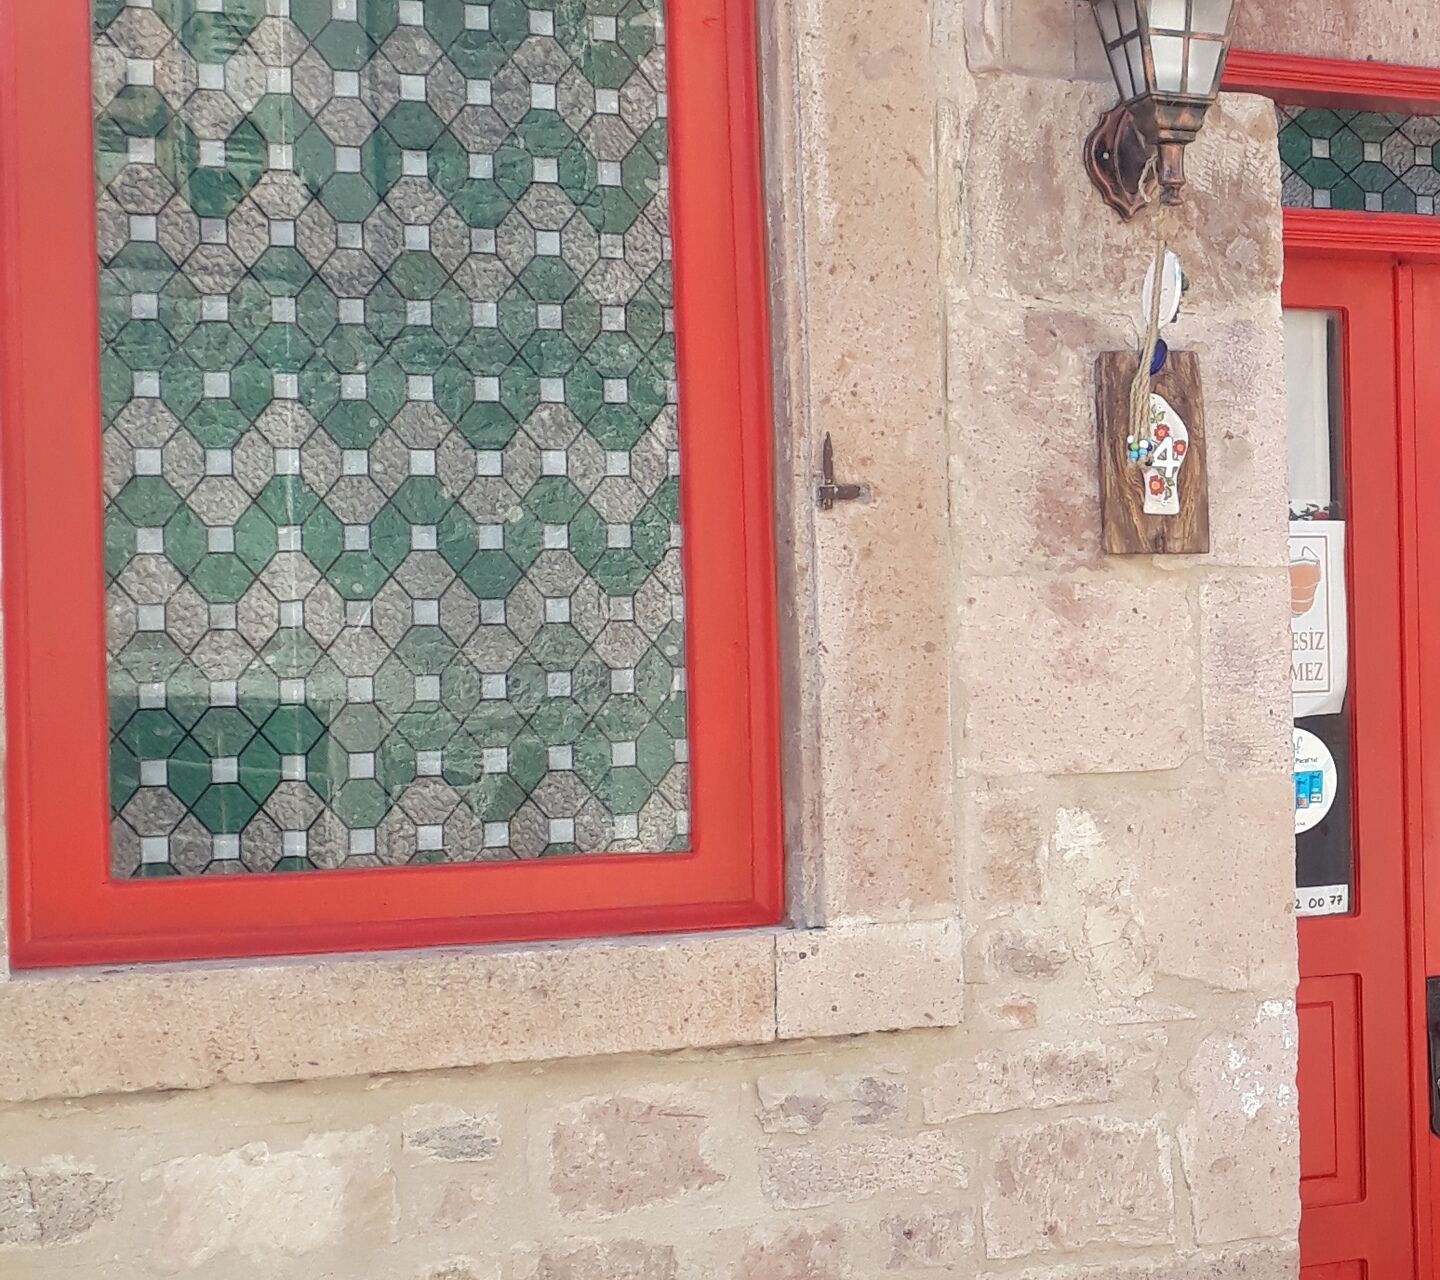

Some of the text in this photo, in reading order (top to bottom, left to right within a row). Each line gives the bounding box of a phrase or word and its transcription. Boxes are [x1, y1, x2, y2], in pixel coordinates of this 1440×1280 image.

[1151, 436, 1180, 478] 4
[1308, 897, 1325, 909] 00
[1329, 895, 1343, 906] 77
